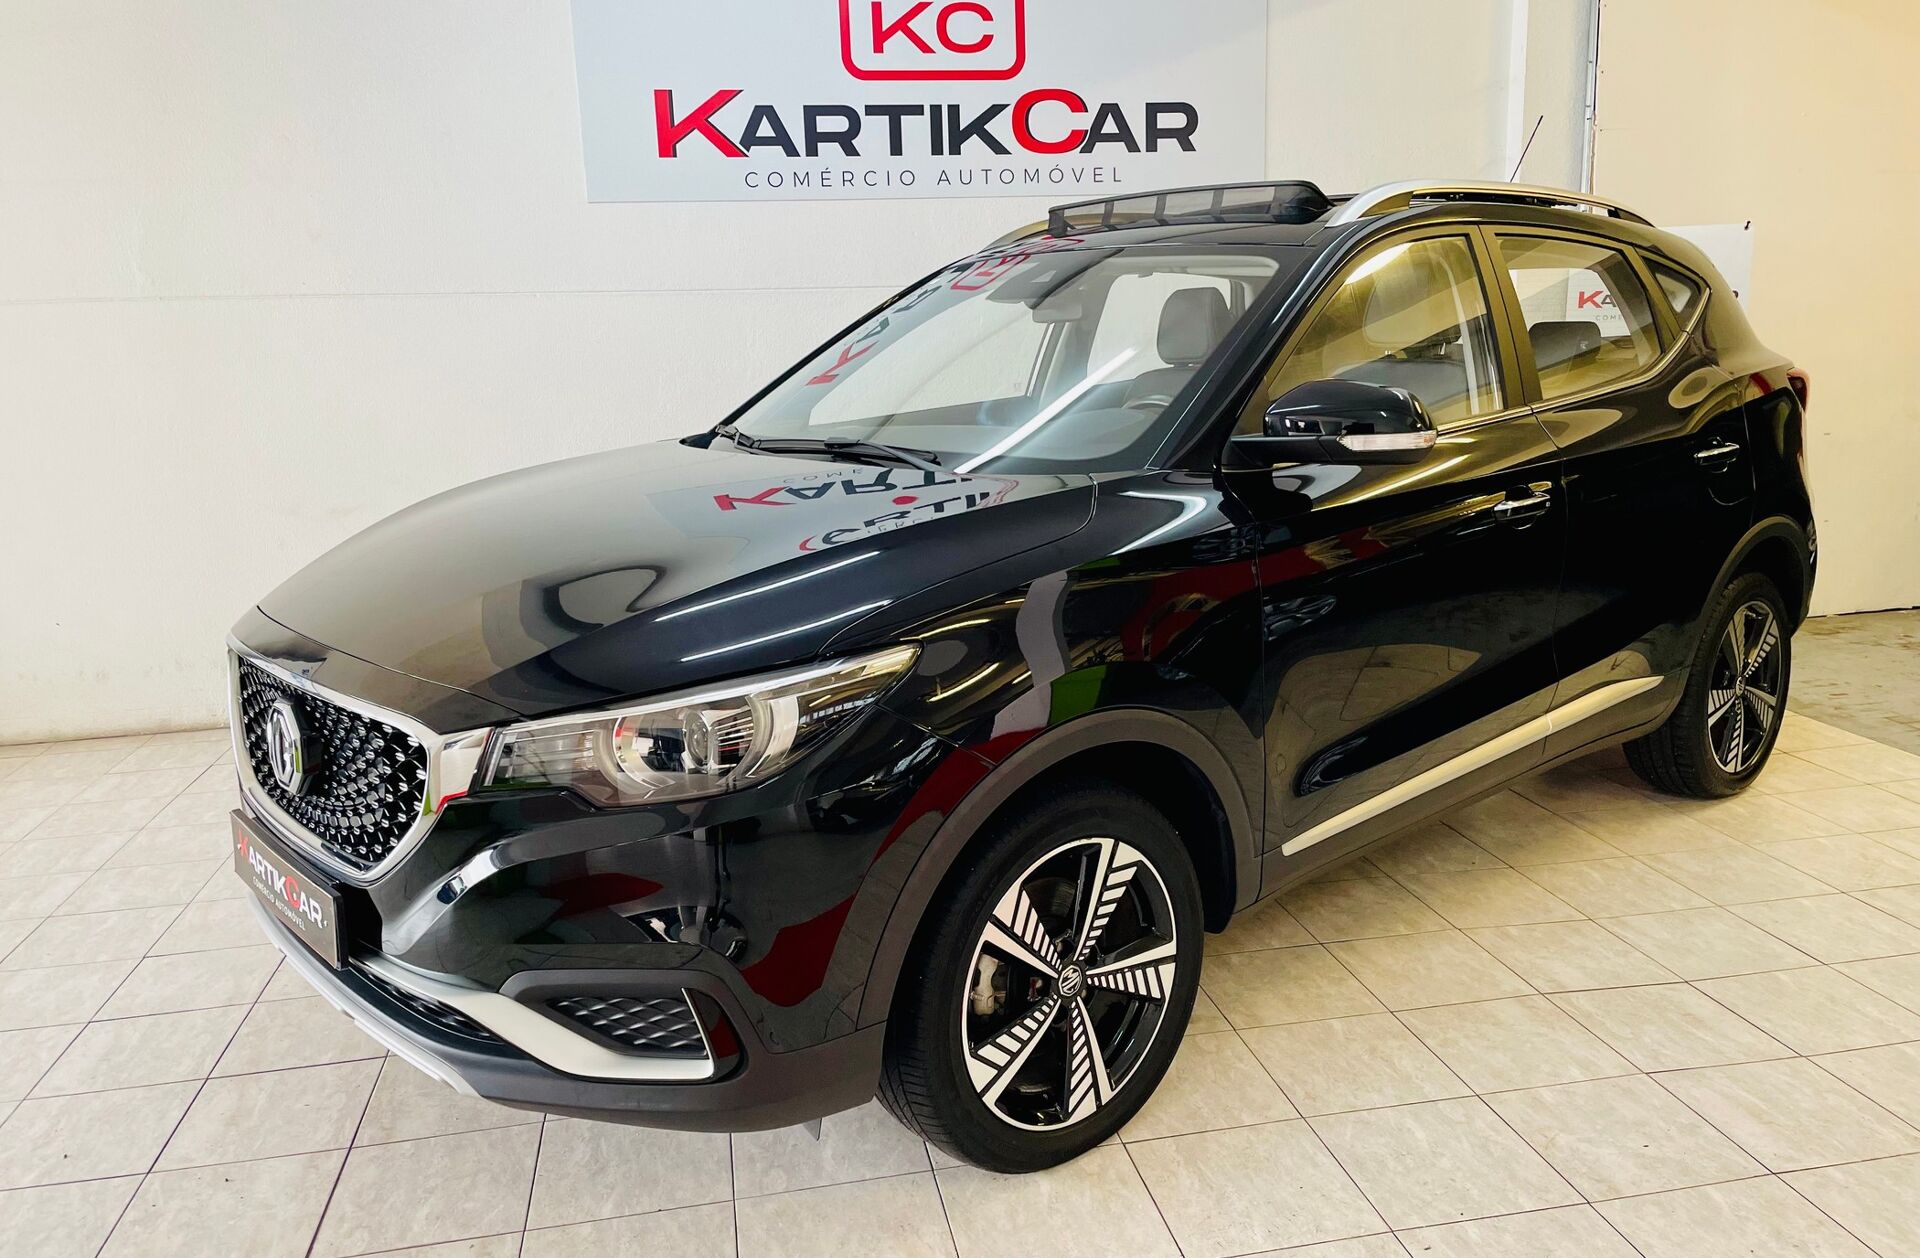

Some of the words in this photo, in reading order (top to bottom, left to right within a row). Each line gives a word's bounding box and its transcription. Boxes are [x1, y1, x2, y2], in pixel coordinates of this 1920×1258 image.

[870, 1, 994, 54] KC
[745, 167, 916, 188] COMÉRCIO
[936, 163, 1122, 186] AUTOMÓVEL
